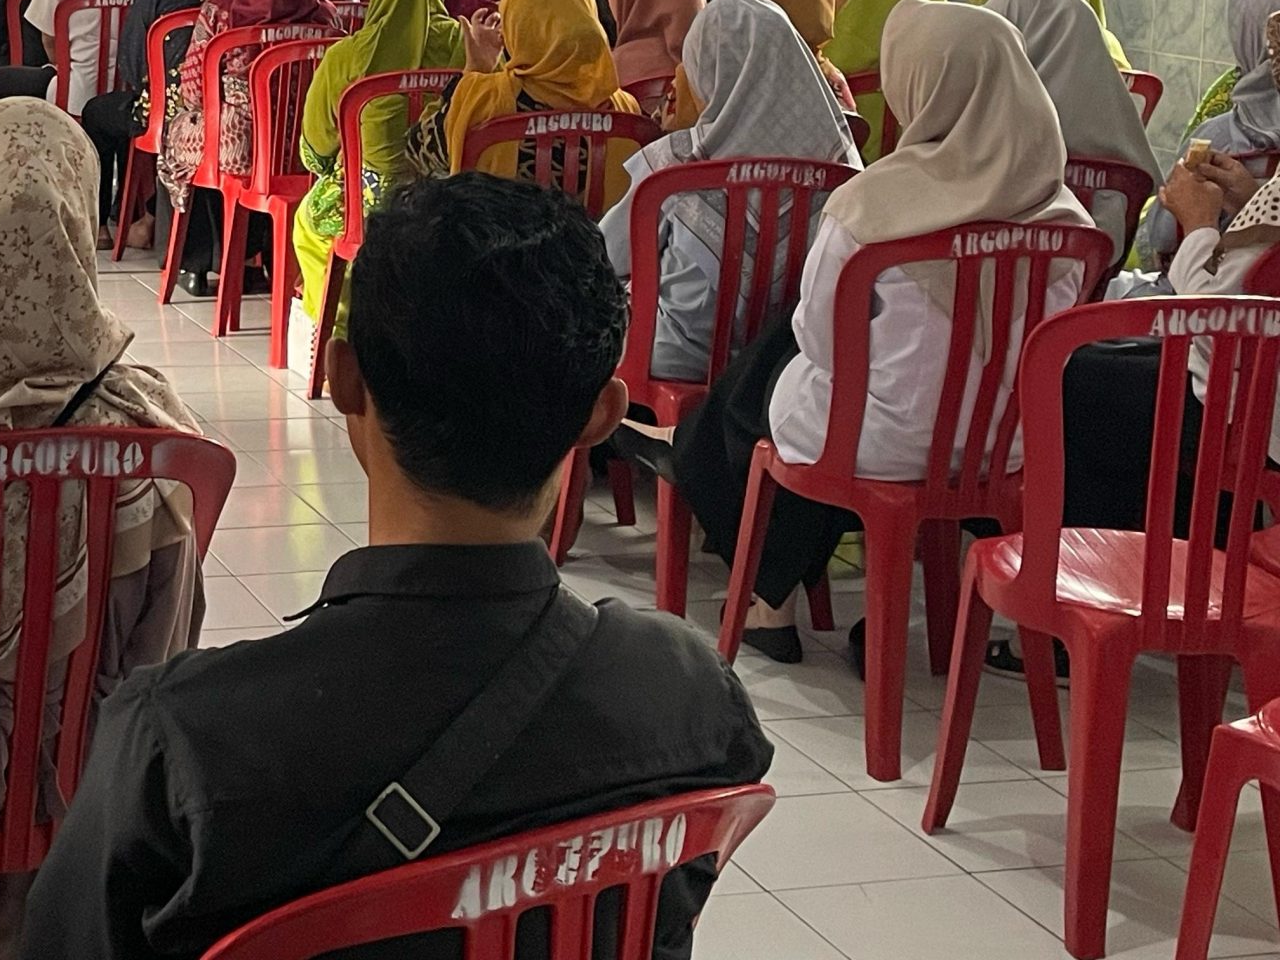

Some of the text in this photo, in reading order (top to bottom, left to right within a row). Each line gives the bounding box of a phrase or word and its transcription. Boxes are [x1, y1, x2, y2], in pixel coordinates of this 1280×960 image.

[260, 26, 322, 43] ARGOPURO
[399, 74, 450, 90] ARGOP
[525, 113, 613, 135] ARGOPURO
[726, 162, 827, 187] ARGOPURO
[951, 227, 1064, 258] ARGOPURO
[1148, 305, 1280, 338] ARGOPUR
